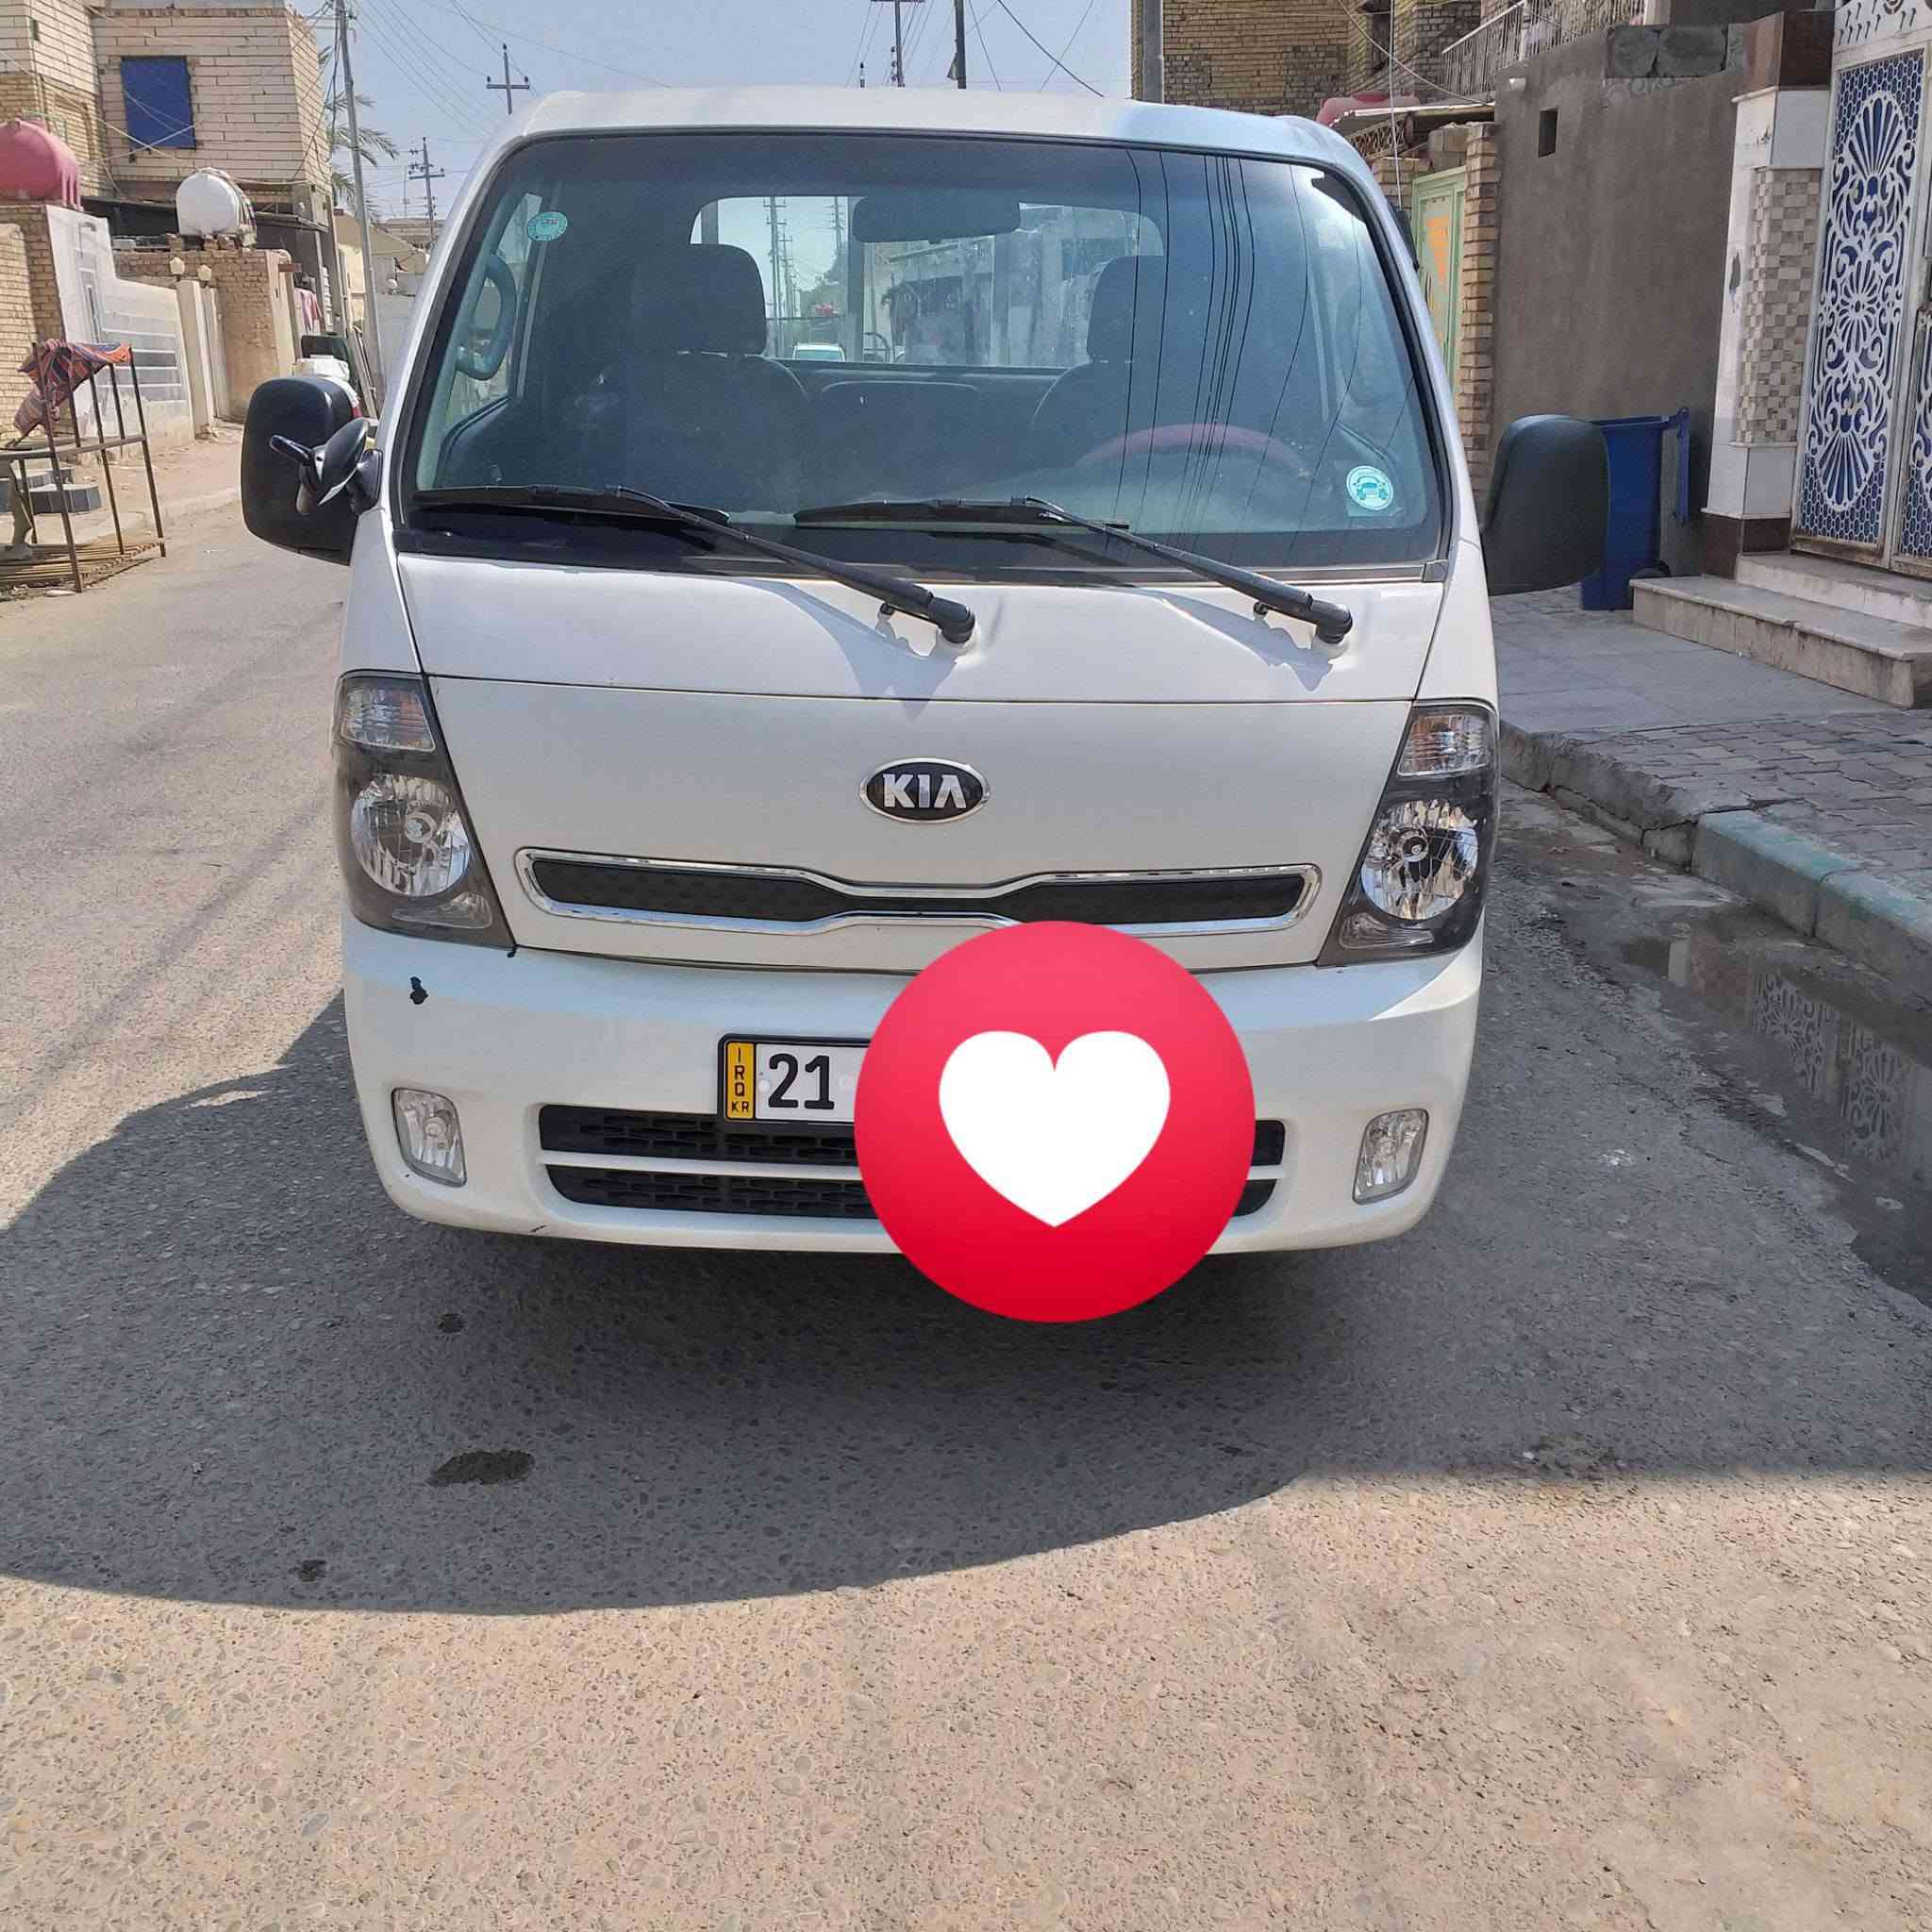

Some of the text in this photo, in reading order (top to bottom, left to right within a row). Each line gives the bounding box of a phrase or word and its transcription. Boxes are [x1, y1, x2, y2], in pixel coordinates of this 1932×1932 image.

[883, 774, 967, 808] KIA
[768, 1053, 835, 1109] 21
[731, 1101, 750, 1113] KR
